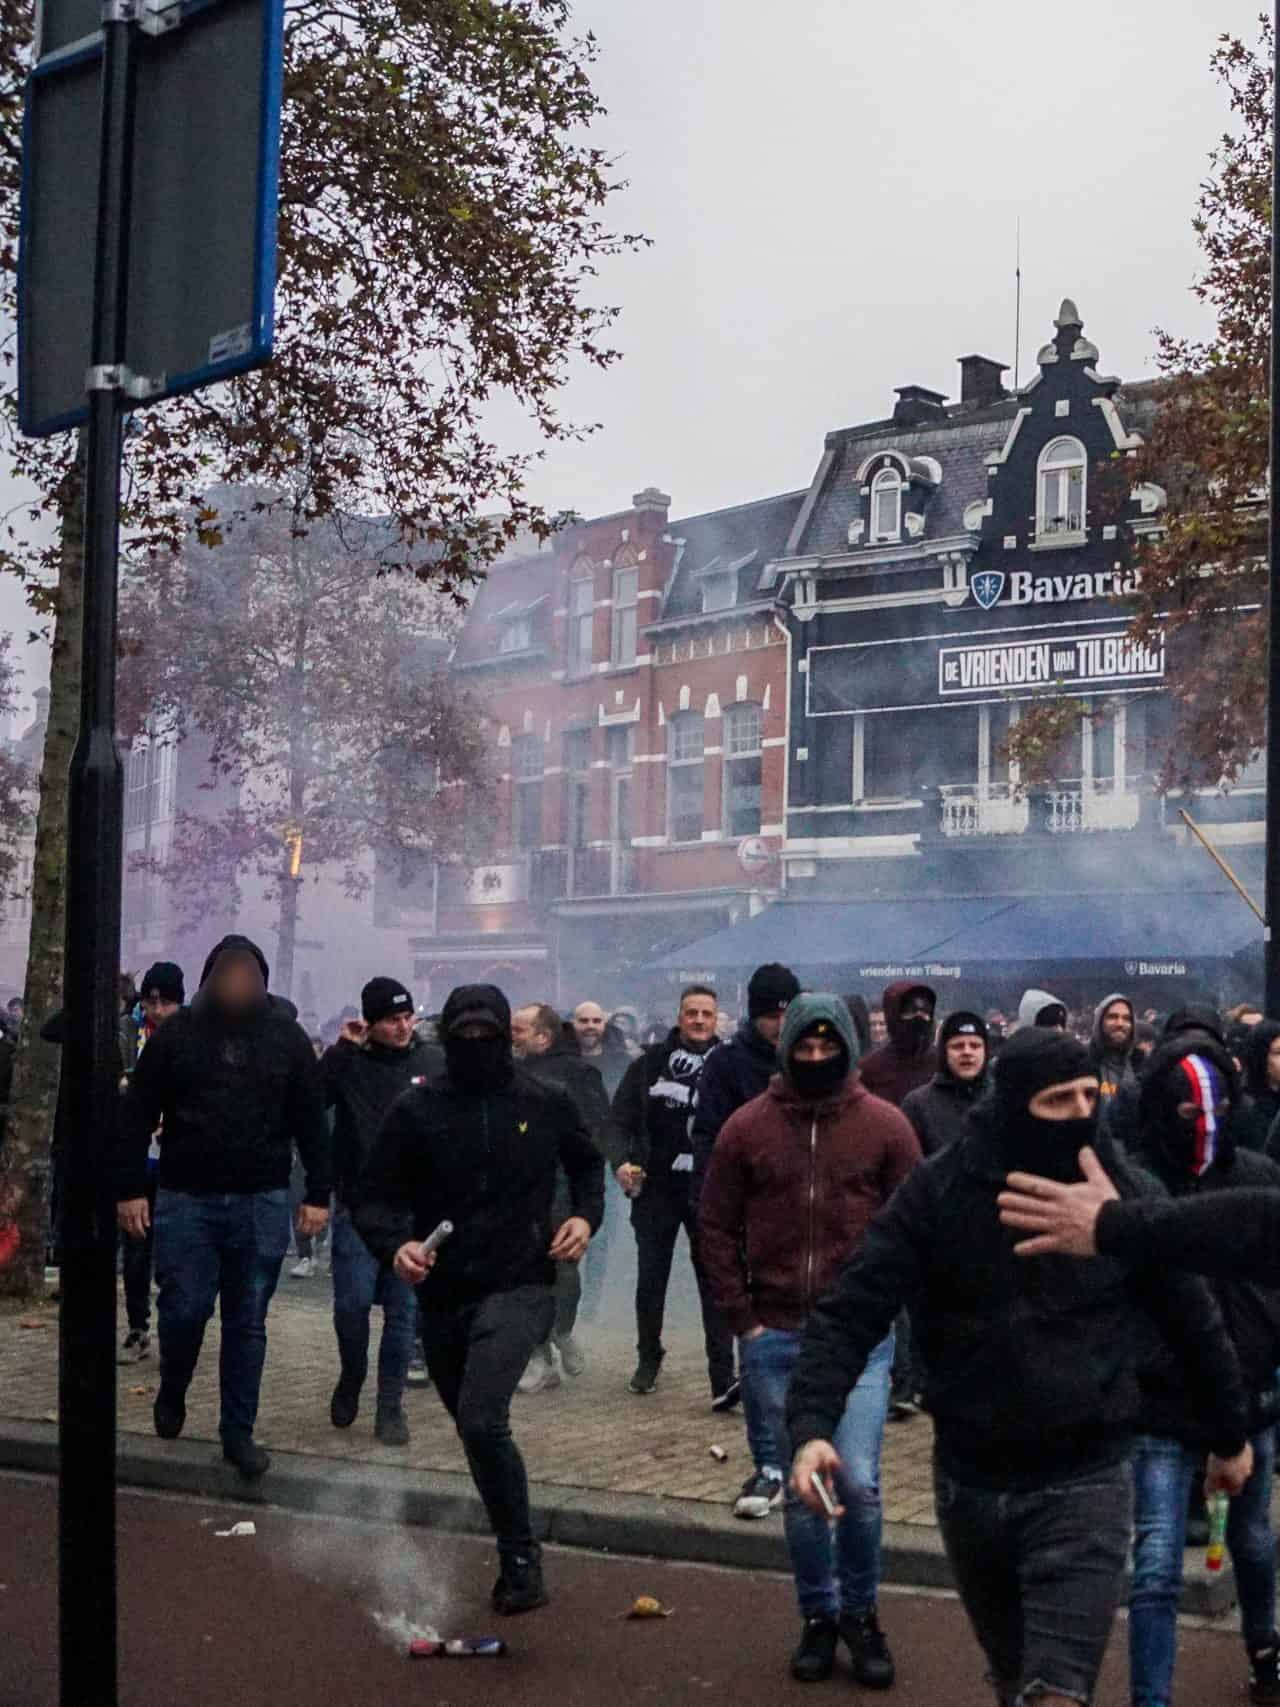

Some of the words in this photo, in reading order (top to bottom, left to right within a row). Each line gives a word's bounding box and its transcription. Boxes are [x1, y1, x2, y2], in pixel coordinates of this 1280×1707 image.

[1010, 561, 1143, 604] Bavaria
[945, 661, 959, 682] DE
[960, 644, 1049, 688] VRIENDEN
[1053, 650, 1075, 672] VAN
[905, 967, 923, 977] van
[923, 963, 961, 979] Tilburg
[1139, 961, 1186, 975] Bavaria
